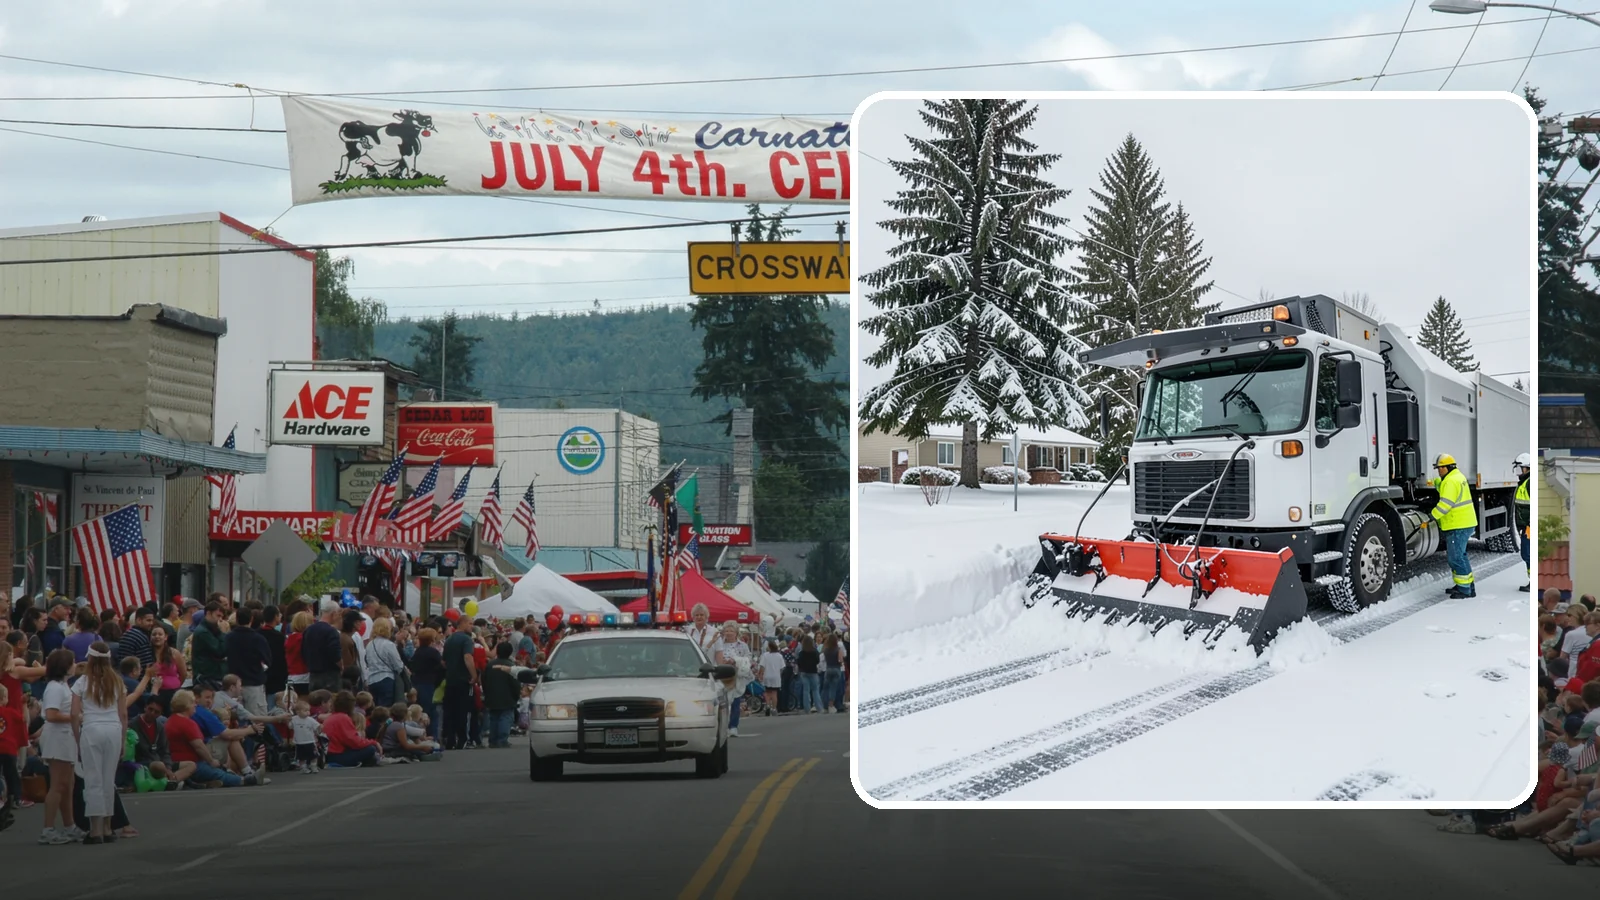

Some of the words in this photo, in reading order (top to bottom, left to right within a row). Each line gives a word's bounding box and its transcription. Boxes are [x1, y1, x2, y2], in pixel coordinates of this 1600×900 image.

[481, 141, 605, 193] JULY
[632, 149, 747, 198] 4th.
[697, 254, 850, 281] CROSSWA
[283, 380, 374, 420] ACE
[405, 409, 453, 422] CEDAR
[461, 409, 485, 422] LOG
[283, 421, 371, 437] Hardware
[416, 428, 478, 447] Coca-Cola
[353, 467, 385, 480] Simpl
[83, 485, 93, 494] St.
[95, 485, 124, 494] Vincent
[126, 486, 136, 494] de
[137, 486, 155, 495] Paul
[213, 516, 330, 535] HARDARE
[688, 526, 741, 535] CRNATION
[699, 535, 730, 543] GLASS
